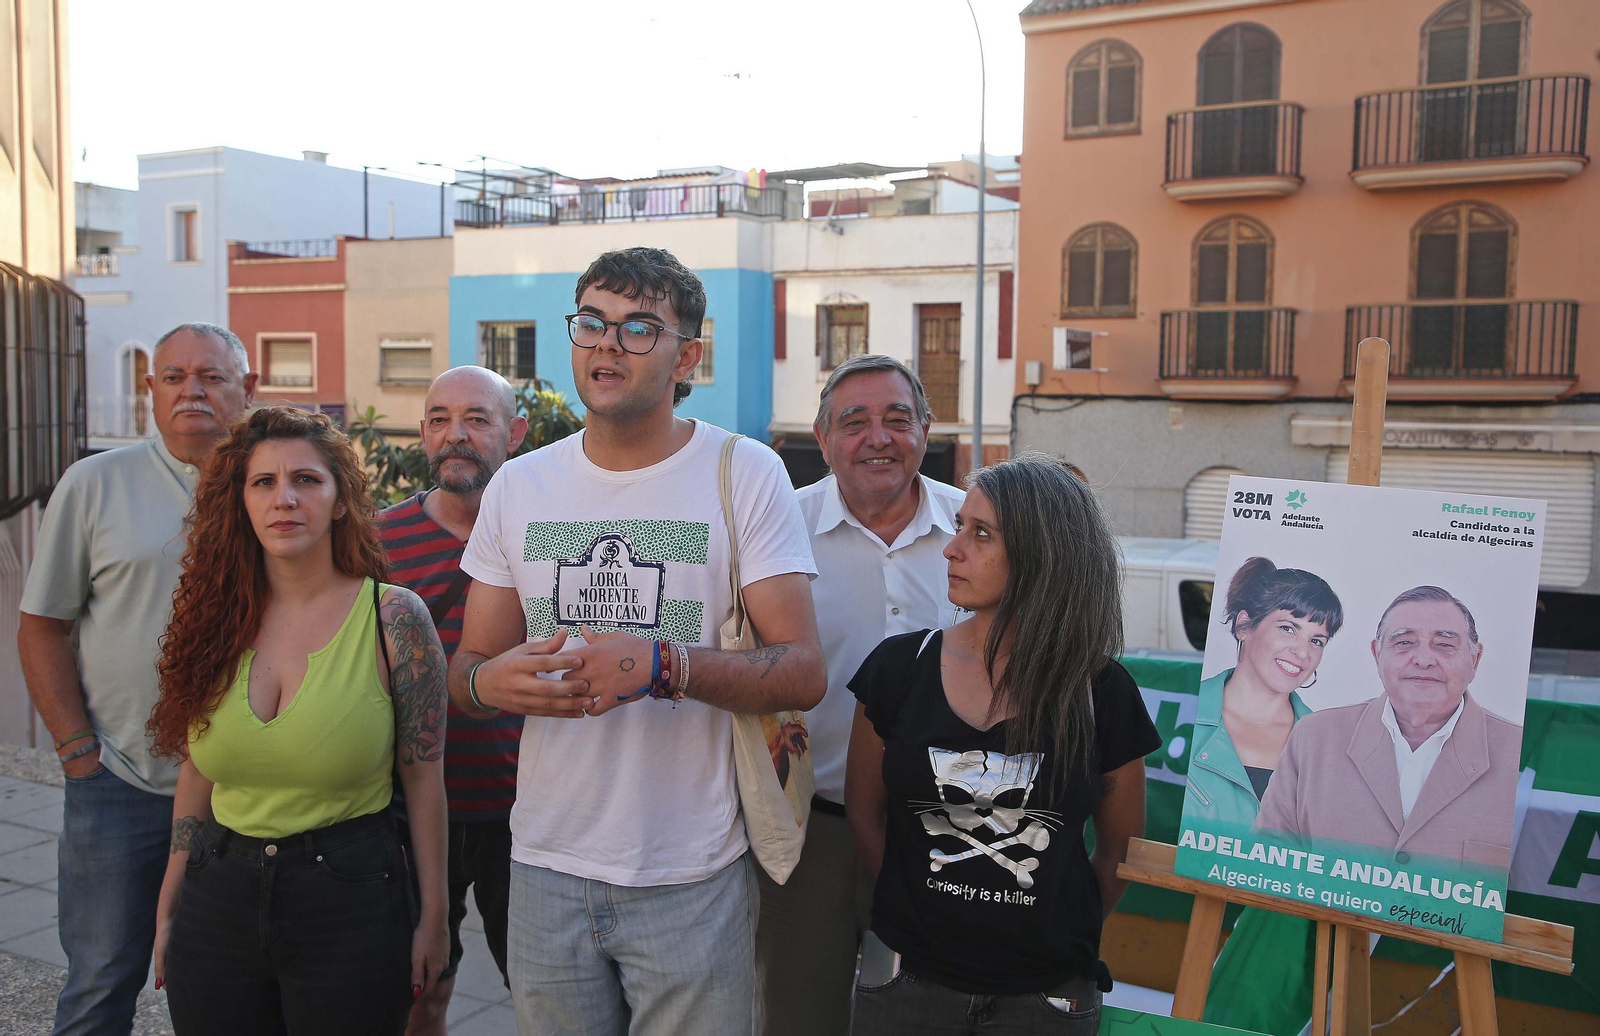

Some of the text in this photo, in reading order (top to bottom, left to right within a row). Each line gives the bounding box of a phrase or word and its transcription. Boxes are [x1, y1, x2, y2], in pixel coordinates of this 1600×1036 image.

[1233, 491, 1273, 506] 28M
[1232, 507, 1272, 521] VOTA
[1281, 512, 1321, 523] Adelante
[1442, 502, 1536, 522] Rafael Fenoy
[1281, 520, 1324, 530] Andalucía
[1450, 520, 1535, 536] Candidato a la
[1412, 529, 1534, 548] alcaldía de Algeciras
[590, 571, 628, 587] LORCA
[578, 588, 639, 604] MORENTE
[566, 604, 647, 621] CARLOS CANO
[1179, 829, 1504, 912] ADELANTE ANDALUCÍA
[980, 888, 990, 901] is
[993, 891, 1001, 903] a
[1004, 889, 1036, 906] killer
[1207, 864, 1468, 935] Algeciras te quiero especial
